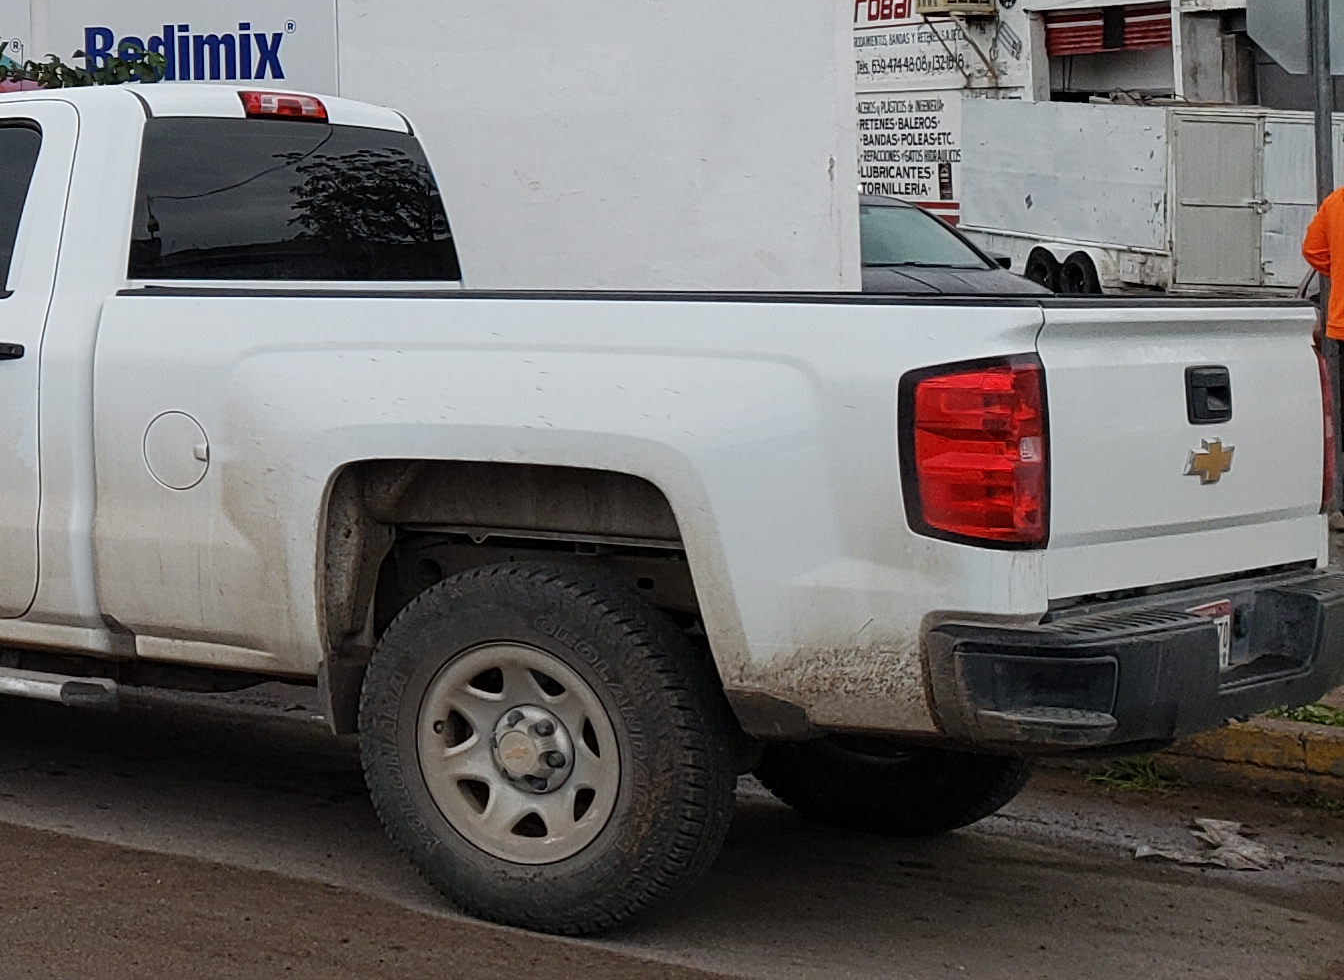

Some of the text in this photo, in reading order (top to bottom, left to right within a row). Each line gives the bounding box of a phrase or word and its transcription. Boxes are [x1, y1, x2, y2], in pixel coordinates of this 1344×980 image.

[859, 116, 938, 131] RETENES BALEROS
[863, 132, 955, 146] BANDAS POLEAS ETC.
[860, 166, 932, 179] LUBRICANTES
